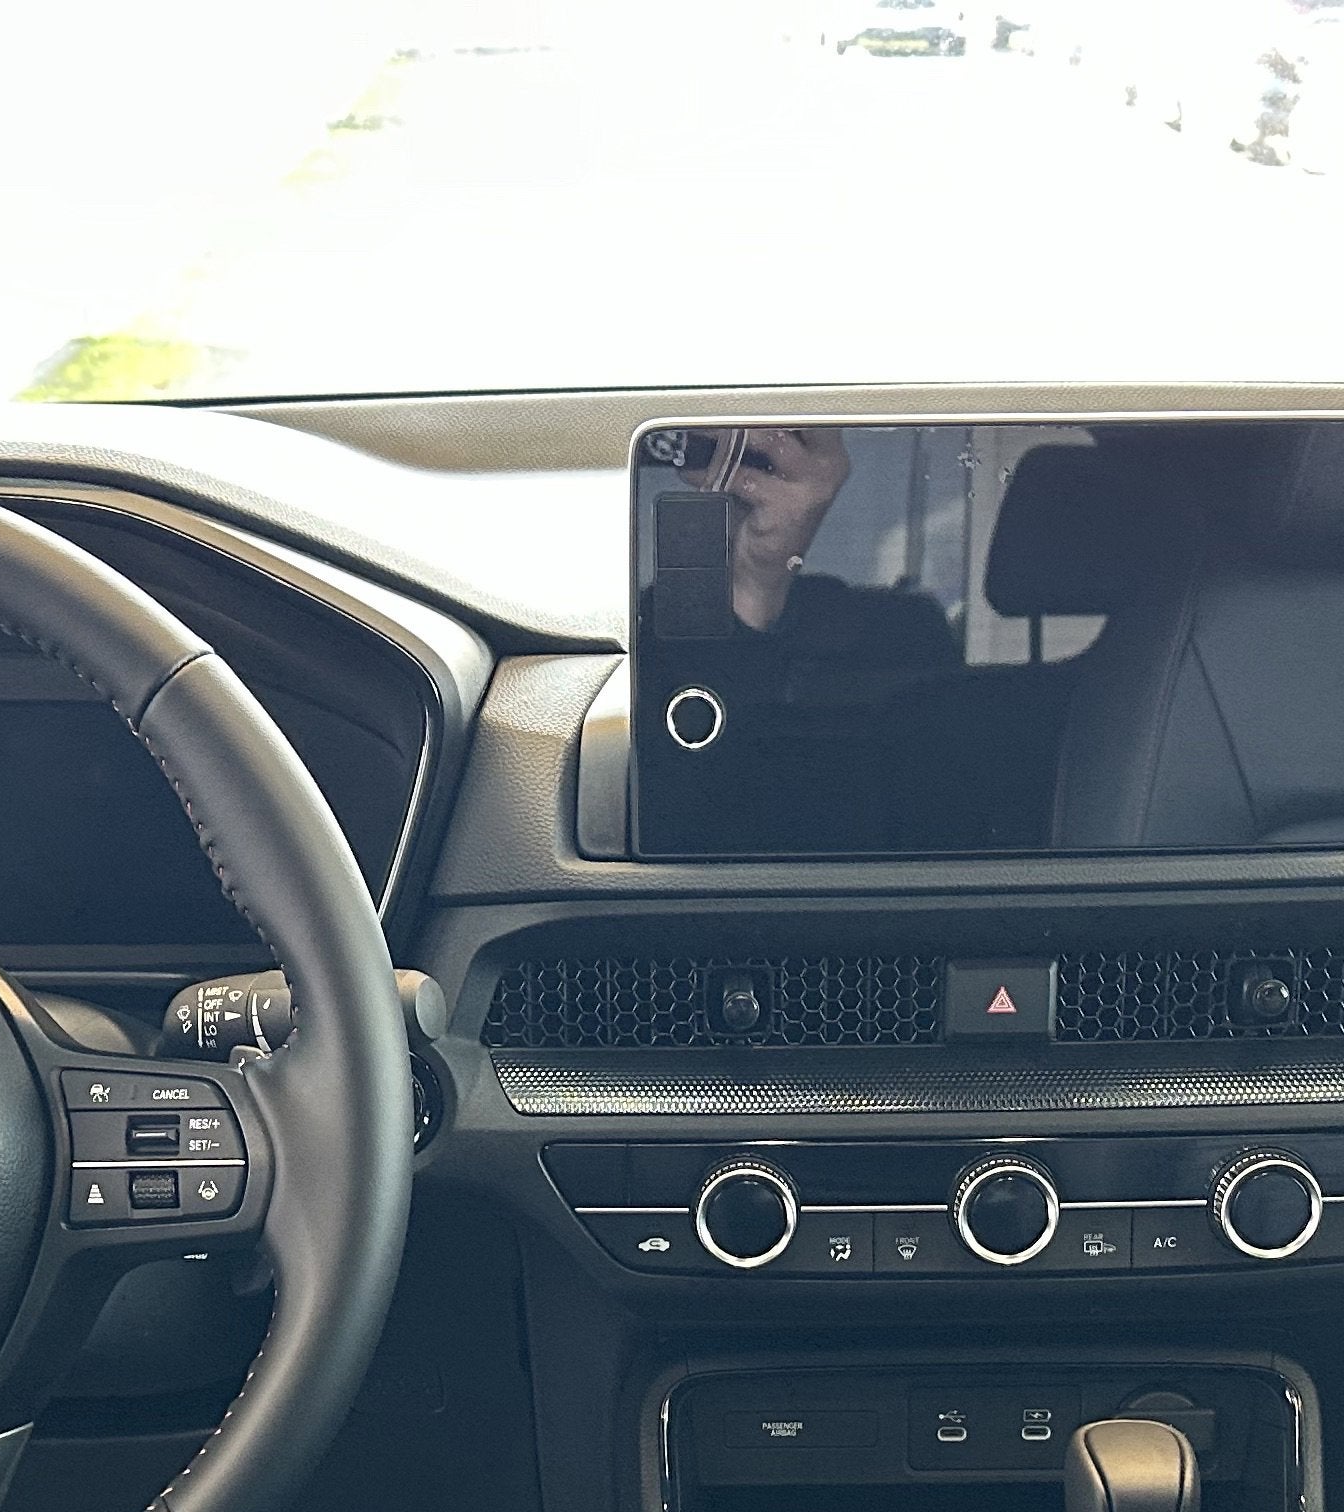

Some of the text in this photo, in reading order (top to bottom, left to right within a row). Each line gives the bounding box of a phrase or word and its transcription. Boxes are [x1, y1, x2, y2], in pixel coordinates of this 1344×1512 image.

[203, 998, 223, 1010] OFF
[203, 1011, 220, 1023] INT
[203, 1024, 217, 1036] LO
[152, 1088, 190, 1100] CANCEL
[189, 1118, 221, 1130] RES/+
[1153, 1236, 1177, 1248] A/C
